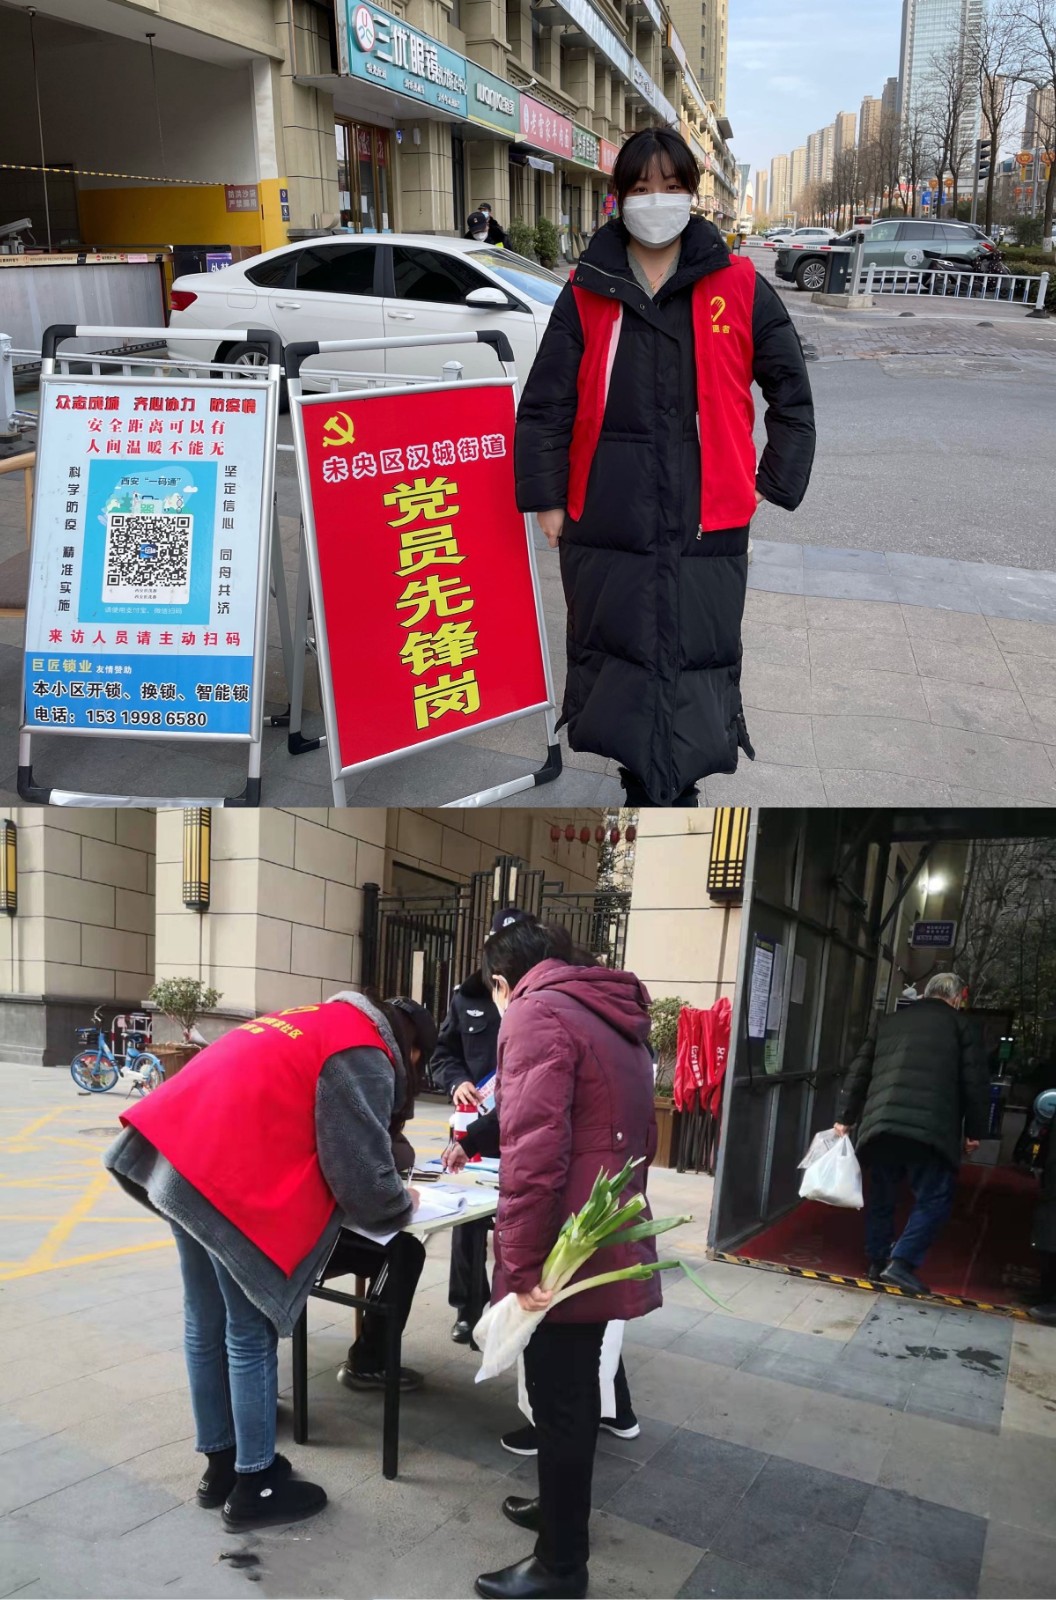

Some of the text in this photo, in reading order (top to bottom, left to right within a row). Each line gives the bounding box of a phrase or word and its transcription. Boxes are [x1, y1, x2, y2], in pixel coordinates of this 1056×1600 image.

[373, 14, 438, 82] 三优眼镜
[55, 395, 257, 414] 众志成城 齐心协力 防疫情
[87, 418, 226, 435] 安全距离可以有
[86, 438, 225, 456] 人间温暖不能无
[323, 434, 507, 483] 未央区汉城街道
[58, 466, 81, 612] 科学防疫 精准实施
[217, 465, 238, 614] 坚定信心 同舟共济
[383, 476, 481, 731] 党员先锋岗
[48, 628, 241, 647] 来访人员请主动扫码
[32, 658, 132, 675] 巨匠锁业 友情赞助
[86, 709, 116, 724] 153
[121, 710, 161, 725] 1998
[165, 711, 207, 727] 6580
